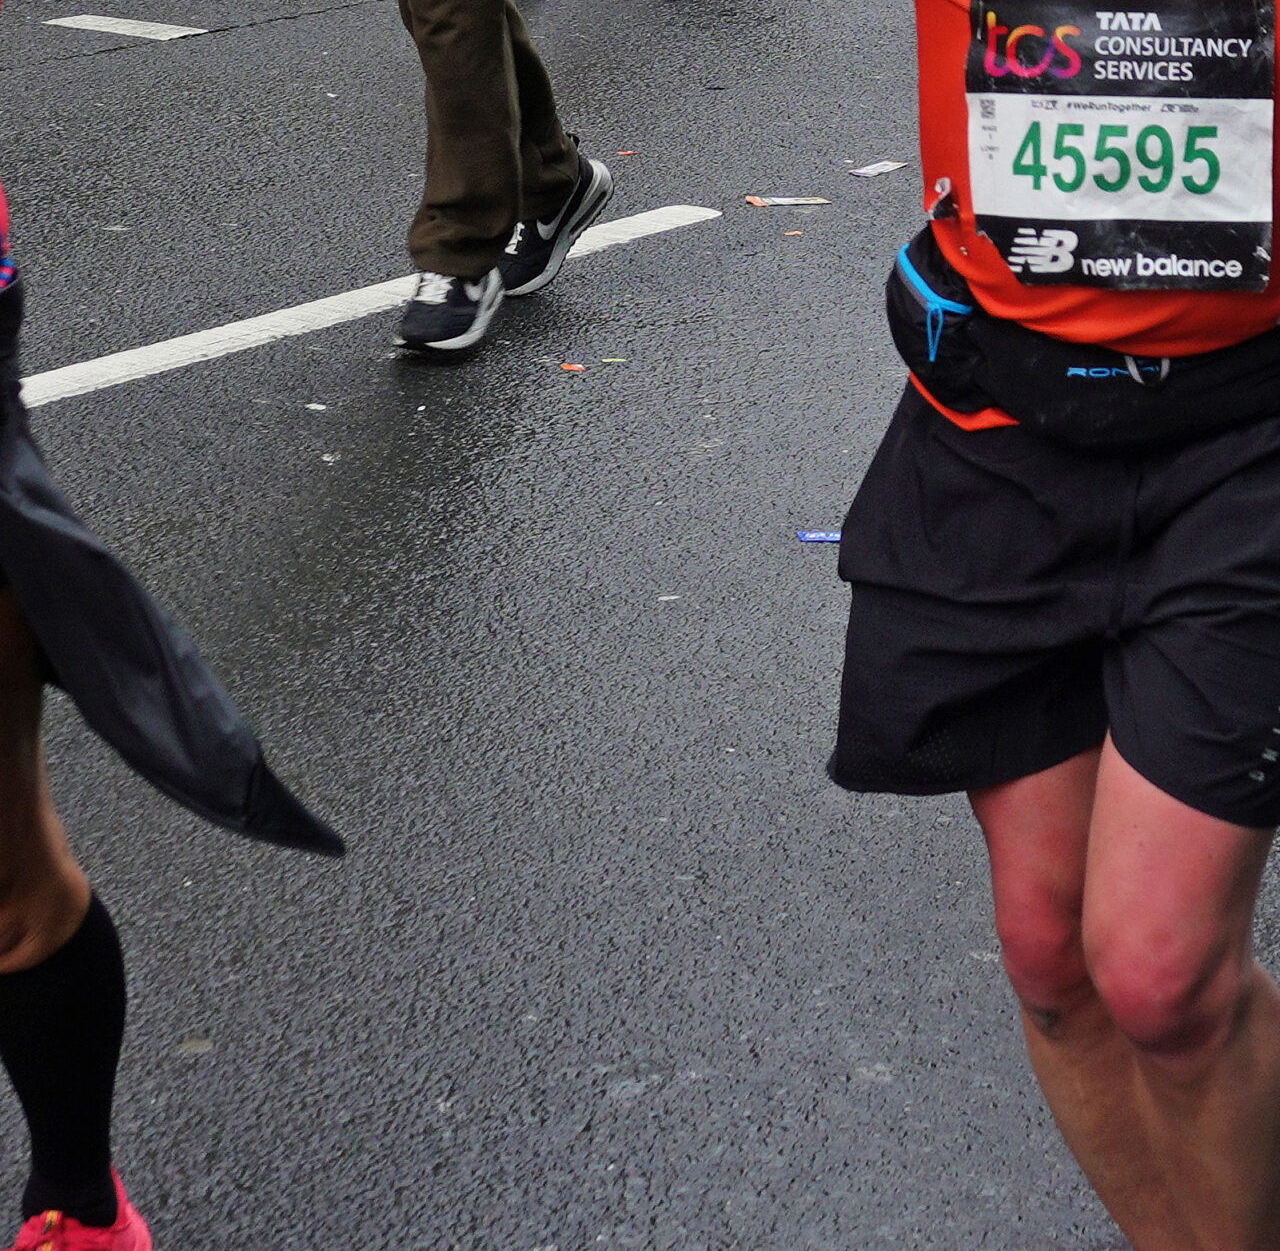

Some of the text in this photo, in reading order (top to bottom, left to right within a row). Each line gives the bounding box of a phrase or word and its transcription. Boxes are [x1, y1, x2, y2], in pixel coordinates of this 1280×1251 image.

[1095, 11, 1162, 32] TATA
[983, 11, 1082, 79] tcs
[1094, 36, 1252, 58] CONSULTANCY
[1094, 60, 1194, 82] SERVICES
[1012, 120, 1221, 195] 45595
[1081, 256, 1132, 278] new
[1137, 253, 1243, 279] balance
